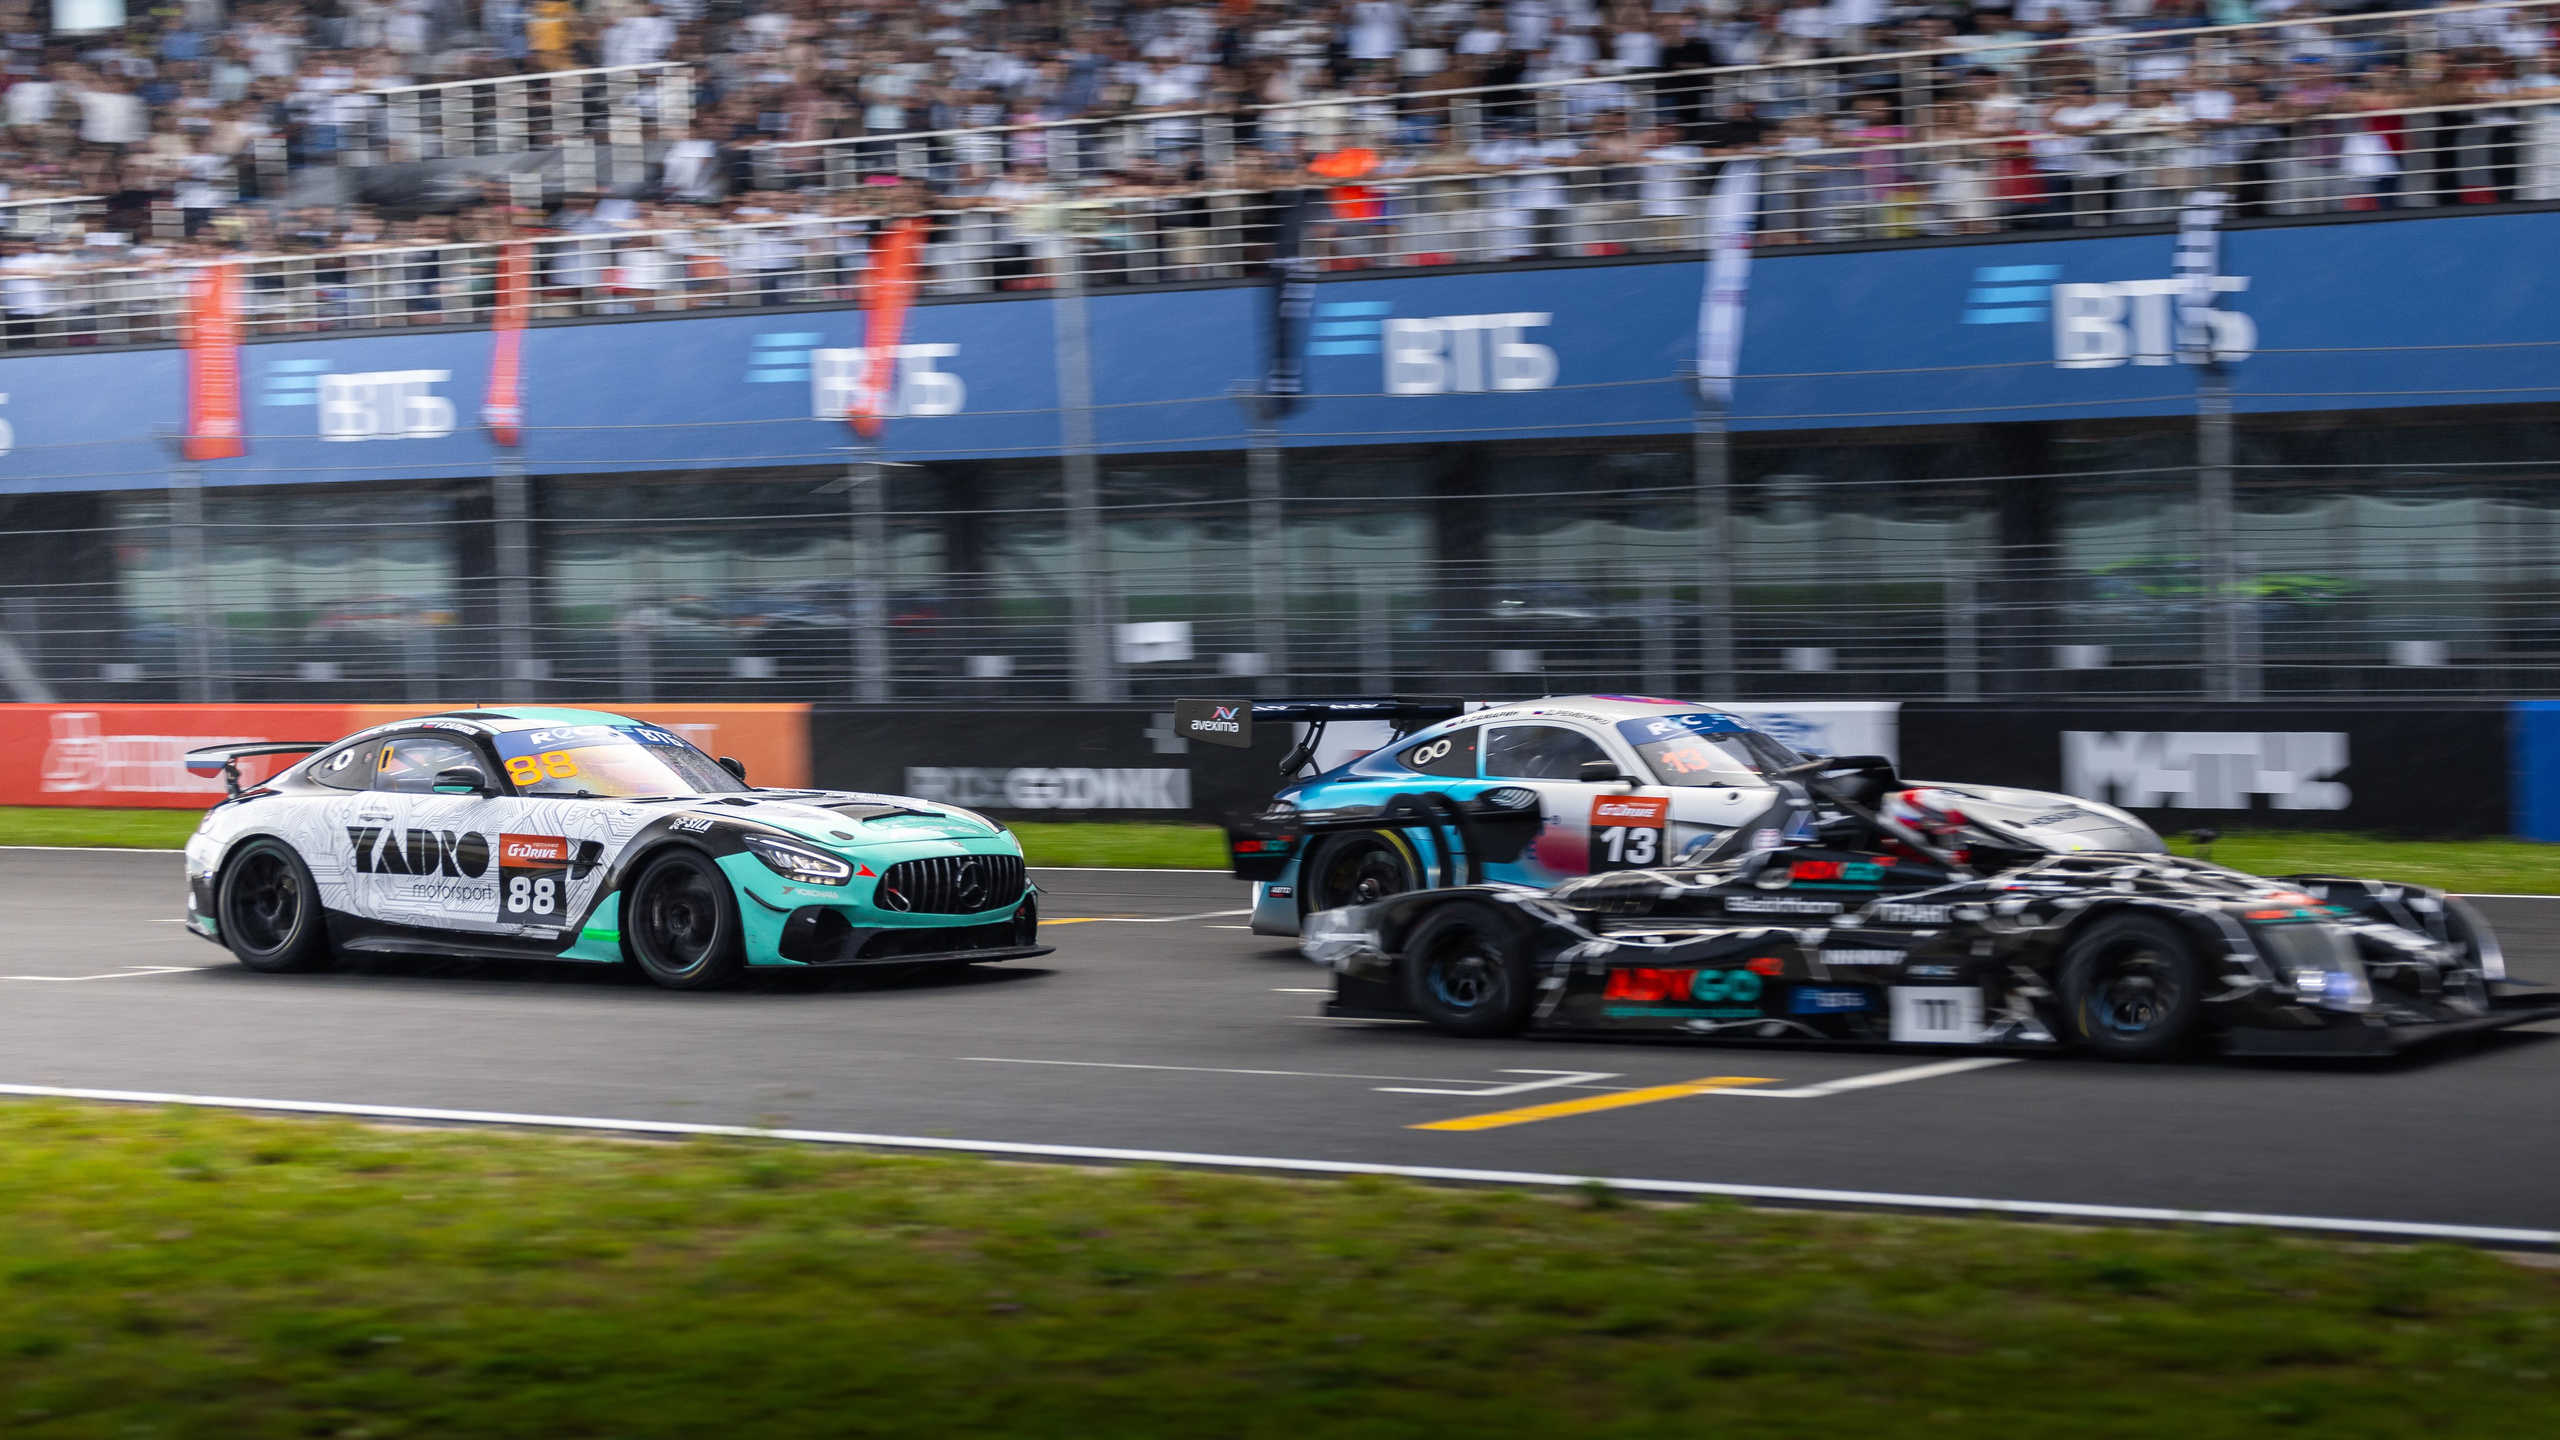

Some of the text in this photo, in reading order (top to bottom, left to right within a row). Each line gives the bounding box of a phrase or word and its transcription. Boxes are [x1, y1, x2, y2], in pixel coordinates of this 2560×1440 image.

[1383, 312, 1559, 396] ВТБ
[316, 369, 457, 442] ВТБ
[635, 727, 684, 748] ВТБ
[1191, 718, 1239, 733] avexima
[505, 750, 578, 786] 88
[1661, 748, 1710, 774] 13
[684, 818, 714, 832] SILA
[346, 826, 490, 879] YADRO
[1600, 826, 1659, 864] 13
[413, 884, 492, 903] motorsport
[508, 876, 556, 915] 88
